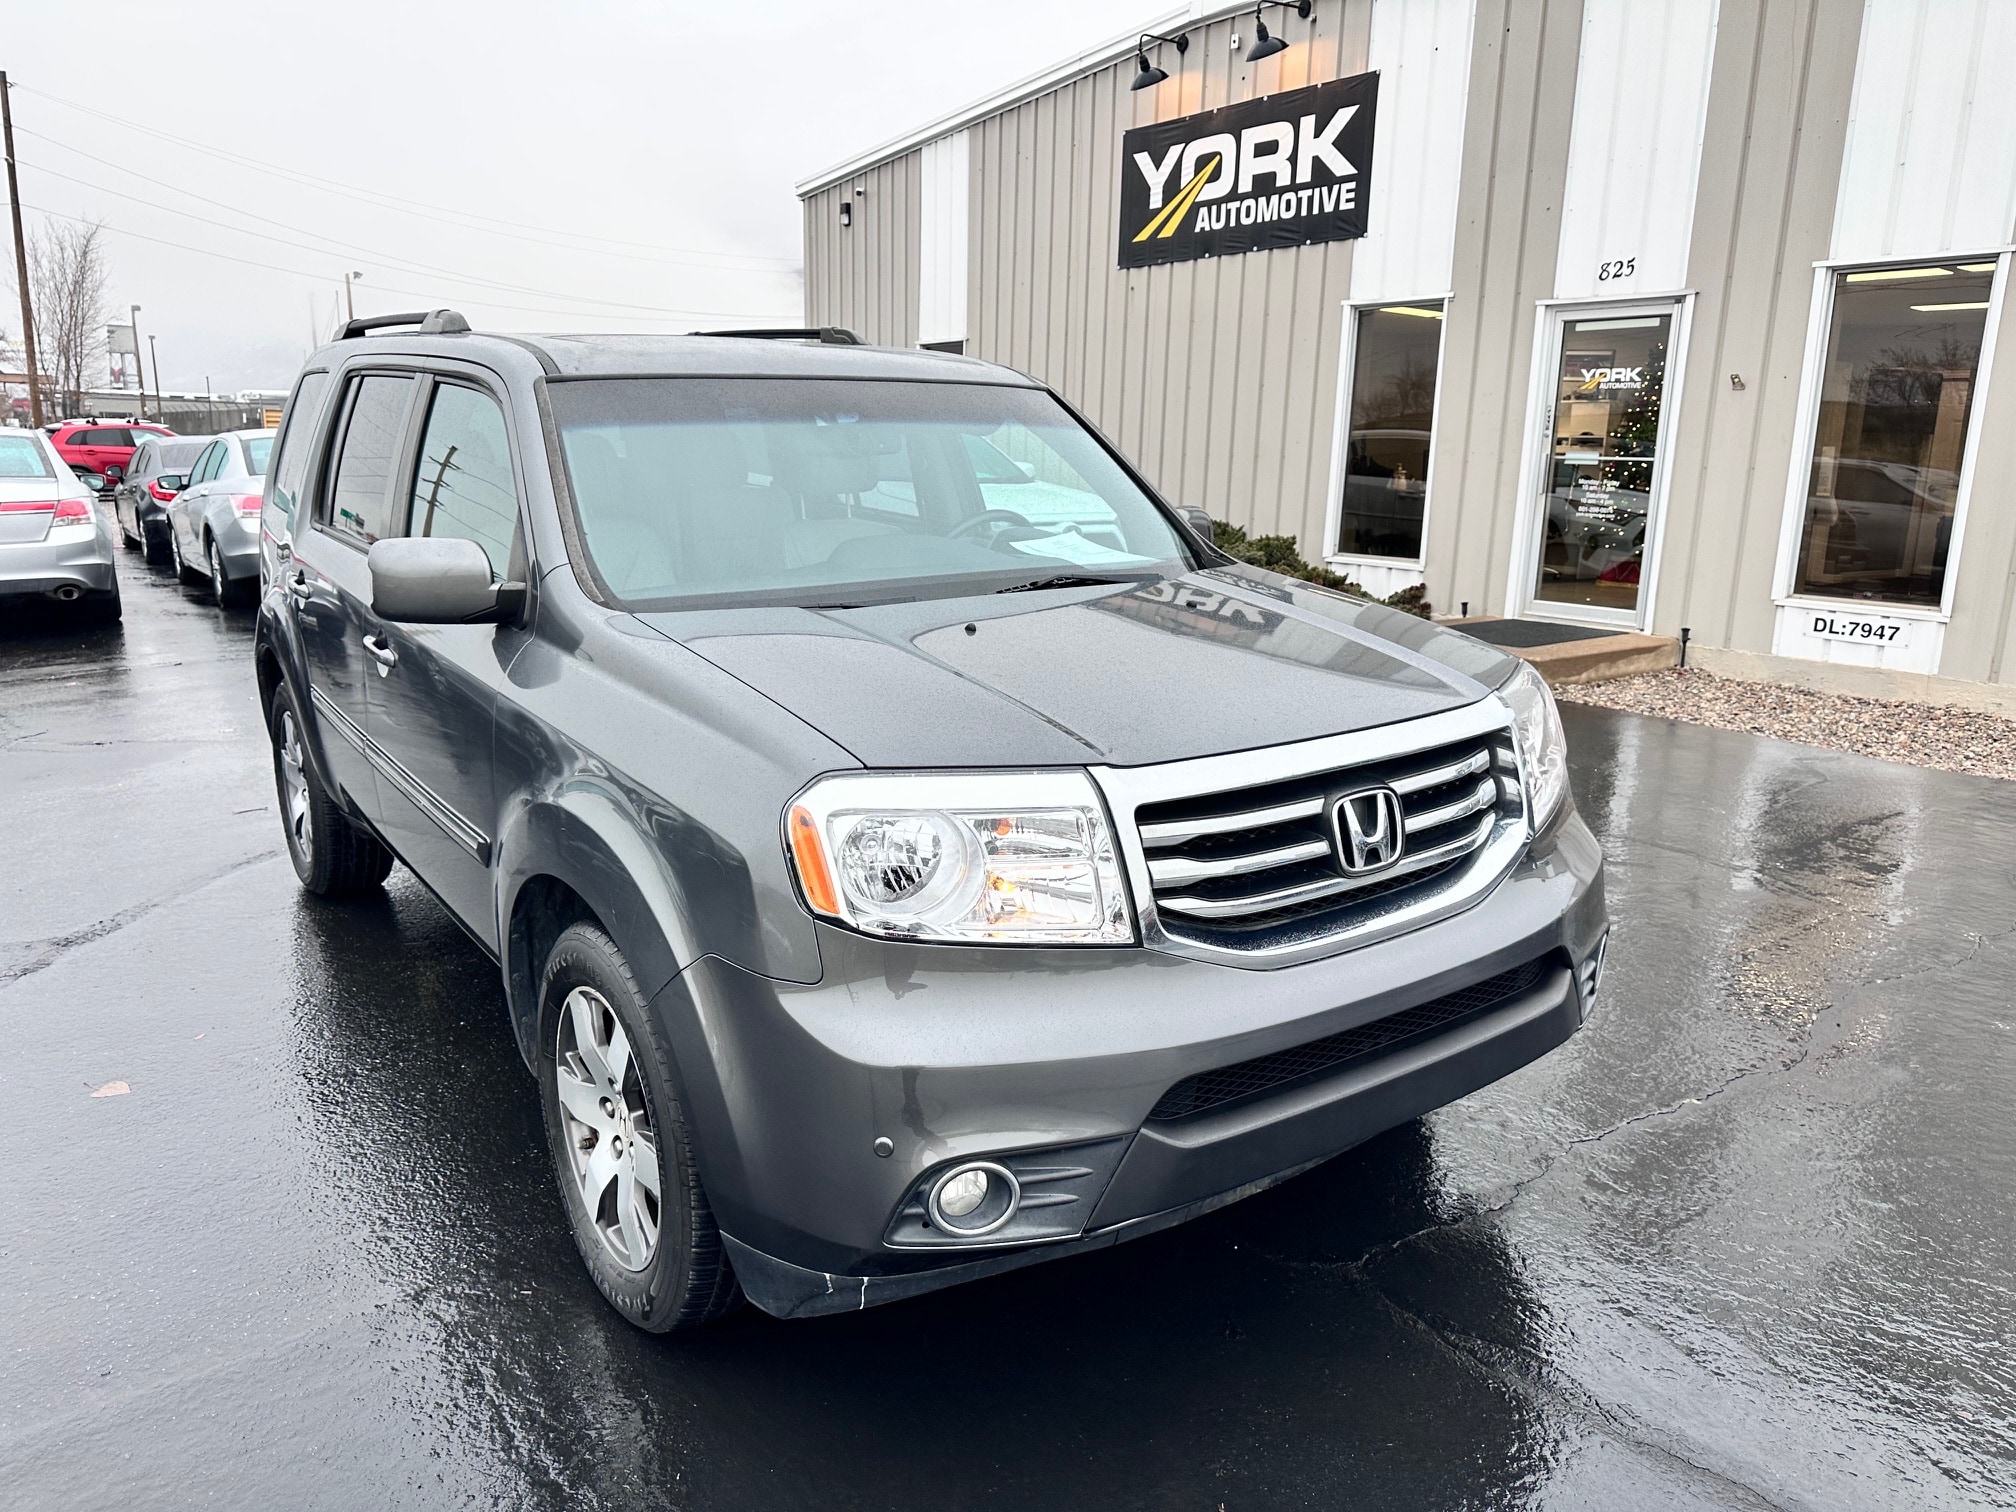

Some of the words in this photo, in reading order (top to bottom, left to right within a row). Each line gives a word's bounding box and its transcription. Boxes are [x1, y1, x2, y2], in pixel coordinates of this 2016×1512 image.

[1132, 104, 1361, 210] YORK
[1194, 181, 1357, 233] AUTOMOTIVE
[1598, 256, 1636, 281] 825
[1580, 367, 1643, 382] YORK
[1586, 491, 1610, 499] Saturday
[1813, 617, 1900, 641] DL:7947
